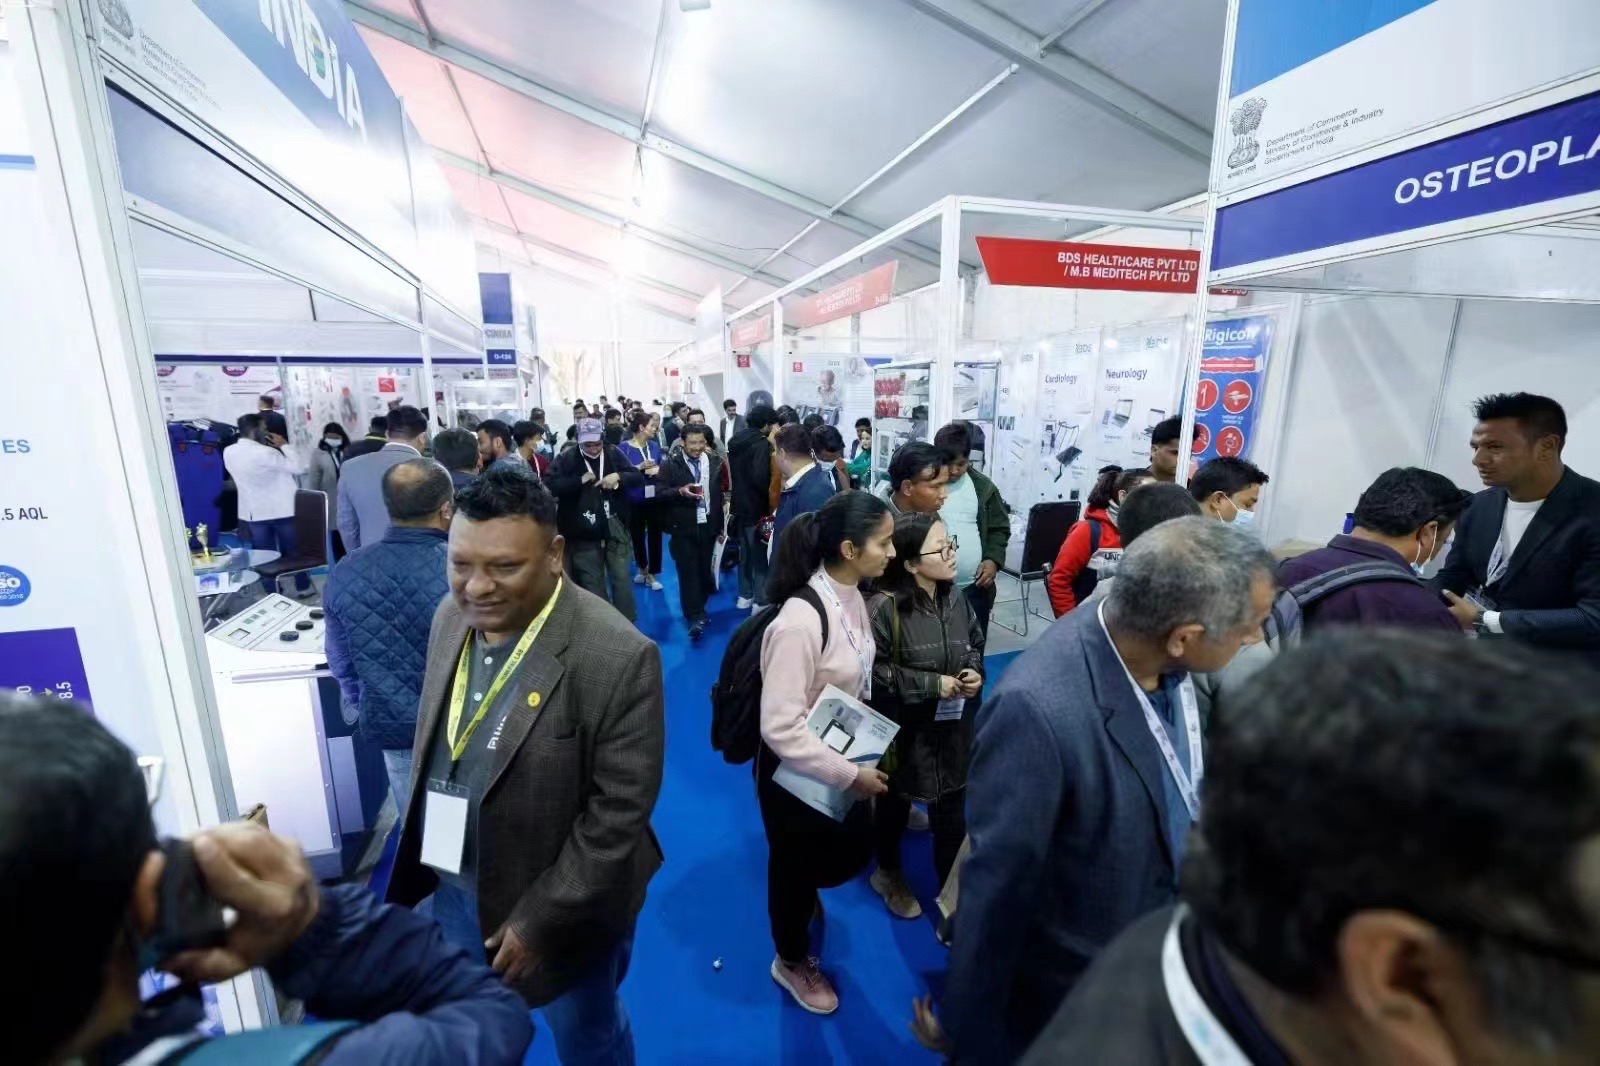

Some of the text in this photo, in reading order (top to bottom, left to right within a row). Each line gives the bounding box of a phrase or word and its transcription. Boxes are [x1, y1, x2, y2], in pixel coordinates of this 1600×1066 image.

[1342, 119, 1349, 127] &
[1351, 107, 1384, 126] Industry
[1266, 129, 1305, 148] Department
[1316, 107, 1358, 128] Commerce
[1315, 135, 1334, 146] India
[1057, 251, 1197, 271] BDS HEALTHCARE PVT LTD
[1070, 265, 1090, 277] M.B
[1092, 267, 1147, 280] MEDITECH
[1149, 270, 1169, 282] PVT
[1171, 271, 1190, 283] LTD
[1045, 373, 1078, 385] Cardiology
[1105, 368, 1148, 381] Neurology
[19, 506, 49, 521] AQL
